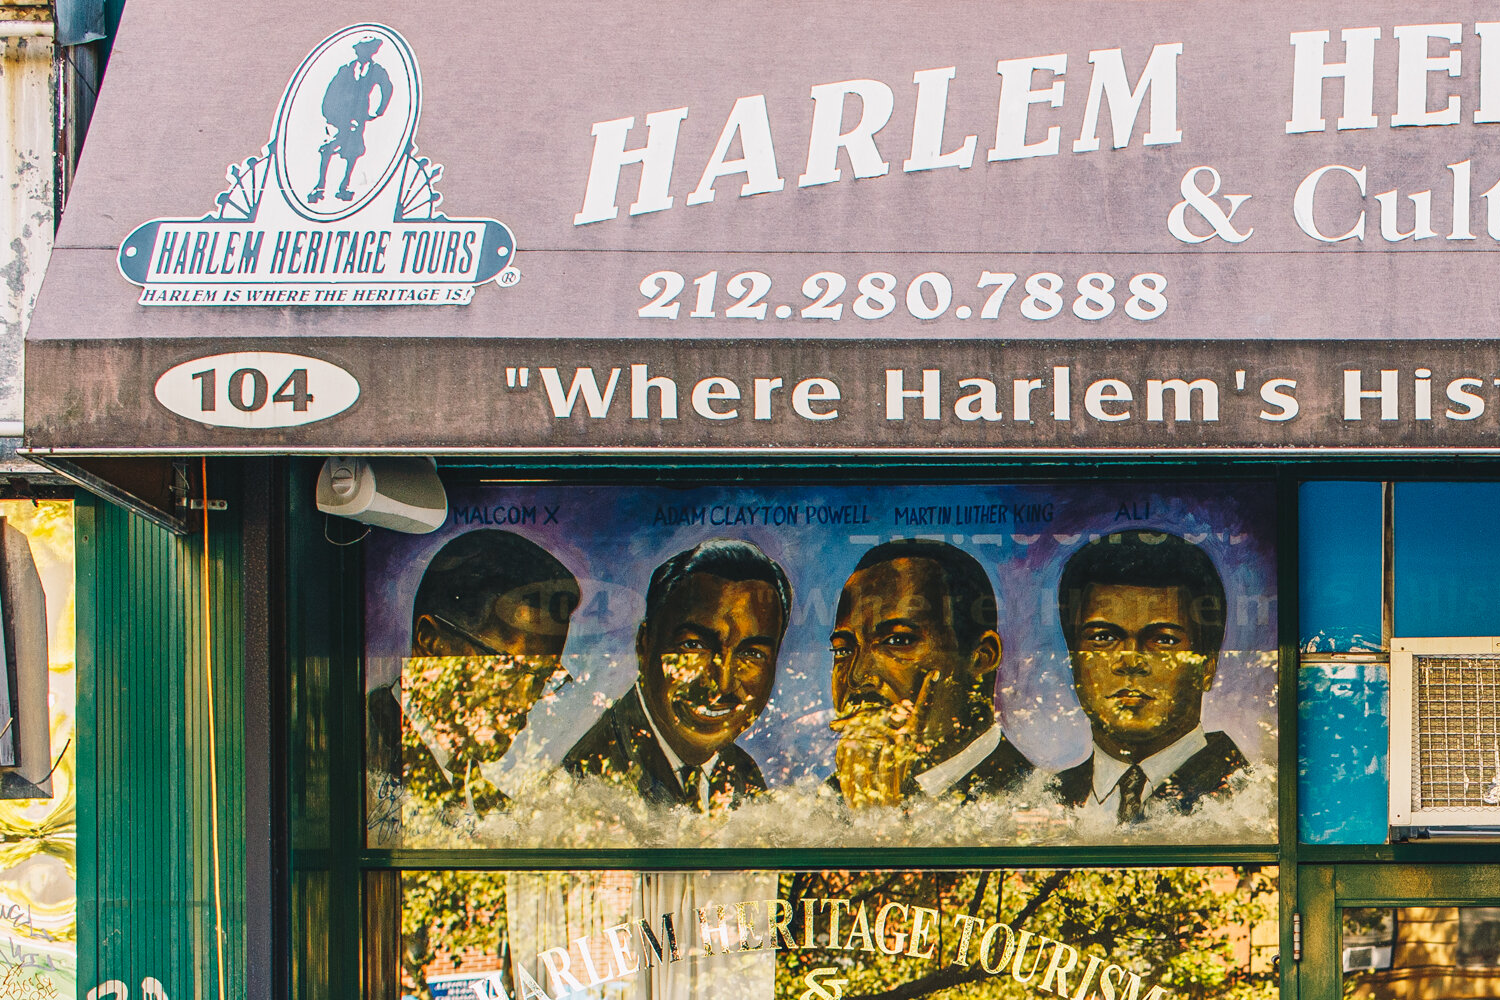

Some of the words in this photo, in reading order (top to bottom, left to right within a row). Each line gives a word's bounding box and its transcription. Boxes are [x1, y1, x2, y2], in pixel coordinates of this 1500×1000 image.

[574, 43, 1184, 226] HARLEM
[1167, 165, 1254, 243] &
[155, 230, 266, 276] HARLEM
[269, 230, 393, 275] HERITAGE
[399, 230, 477, 274] TOURS
[142, 289, 217, 302] HARLEM
[222, 289, 242, 302] IS
[246, 289, 309, 302] WHERE
[314, 288, 348, 302] THE
[354, 288, 440, 302] HERITAGE
[444, 287, 476, 301] IS!
[637, 270, 1168, 321] 212.280.7888
[191, 367, 314, 412] 104
[506, 364, 841, 420] "Where
[885, 366, 1299, 422] Harlem's
[453, 505, 537, 525] MALCOM
[543, 505, 560, 525] X
[652, 505, 706, 527] ADAM
[709, 504, 798, 526] CLAYTON
[804, 504, 871, 526] POWELL
[894, 504, 950, 526] MARTIN
[956, 503, 1008, 525] LUTHER
[1012, 502, 1055, 523] KING
[1113, 501, 1151, 522] ALI
[696, 897, 939, 960] HERITAGE
